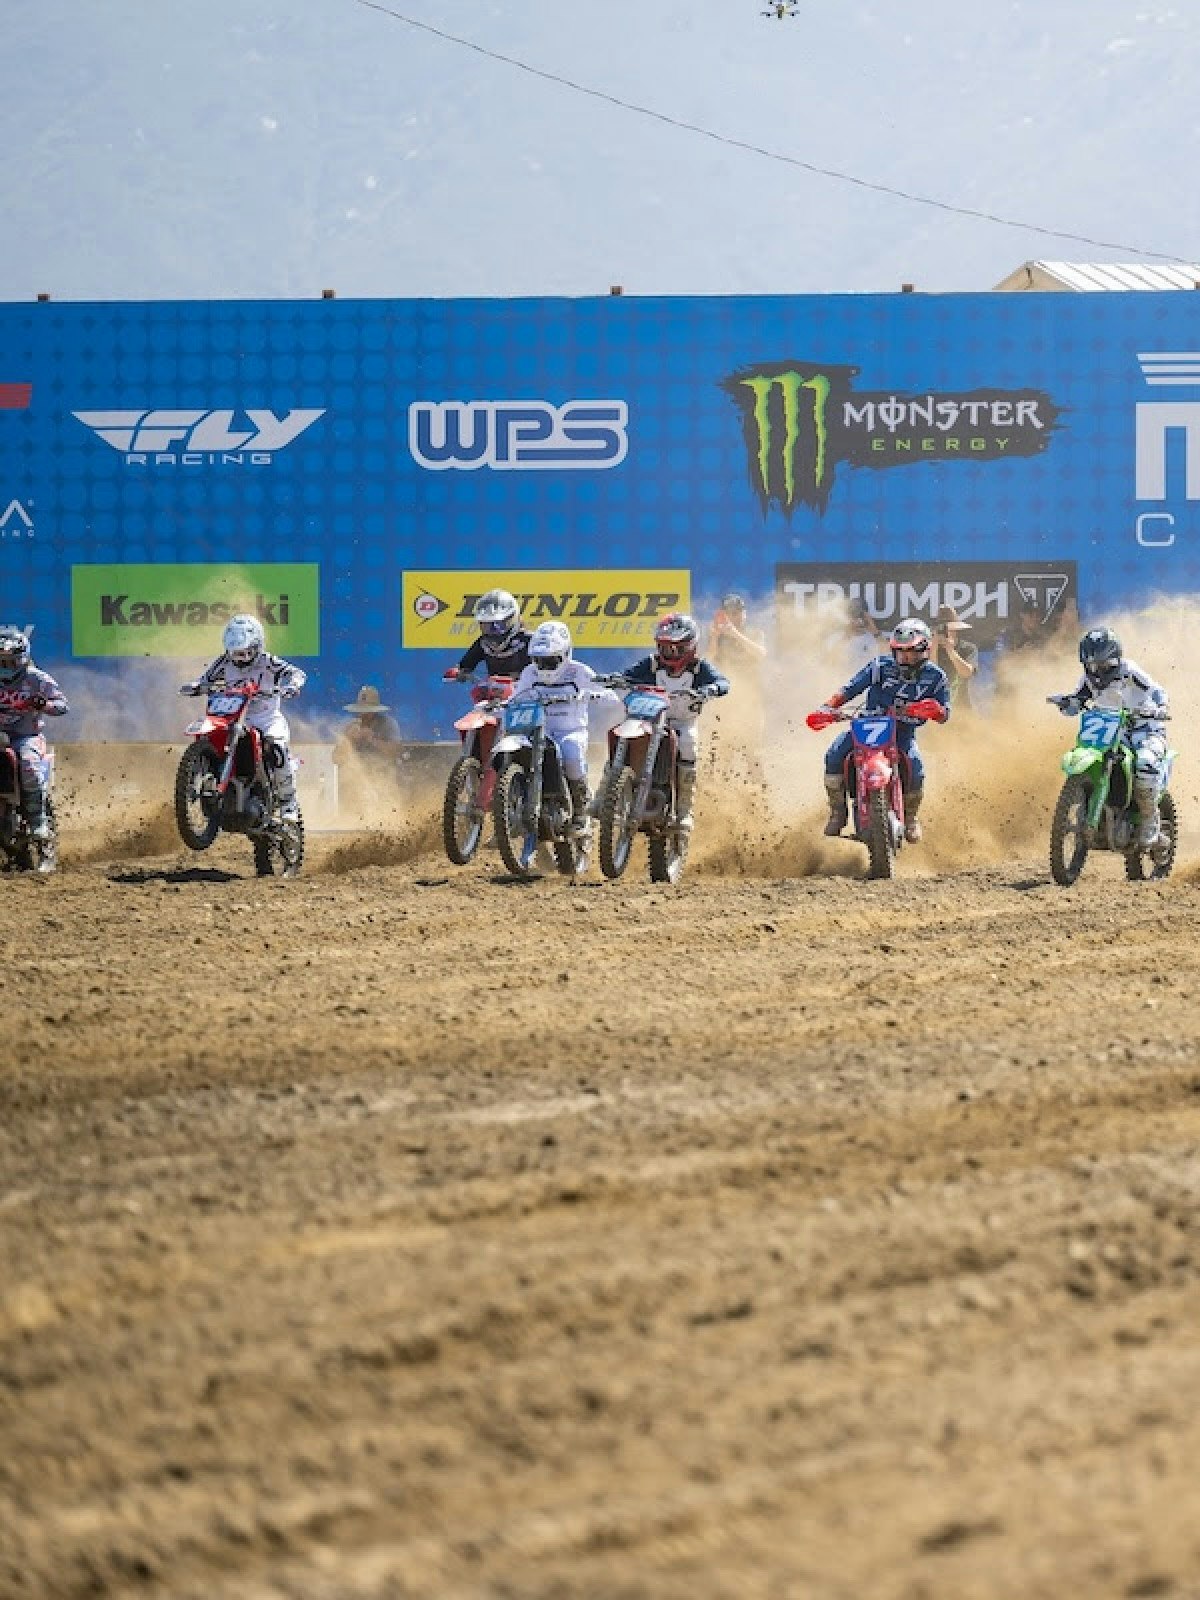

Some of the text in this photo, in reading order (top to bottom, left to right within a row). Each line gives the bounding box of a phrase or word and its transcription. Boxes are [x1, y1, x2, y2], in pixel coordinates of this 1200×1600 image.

[72, 409, 327, 451] FLY
[843, 396, 1045, 433] MONSTER
[404, 400, 628, 470] WPS
[870, 437, 1011, 451] ENERGY
[126, 453, 273, 465] RACING
[101, 594, 288, 626] Kawaski
[863, 721, 888, 744] 7
